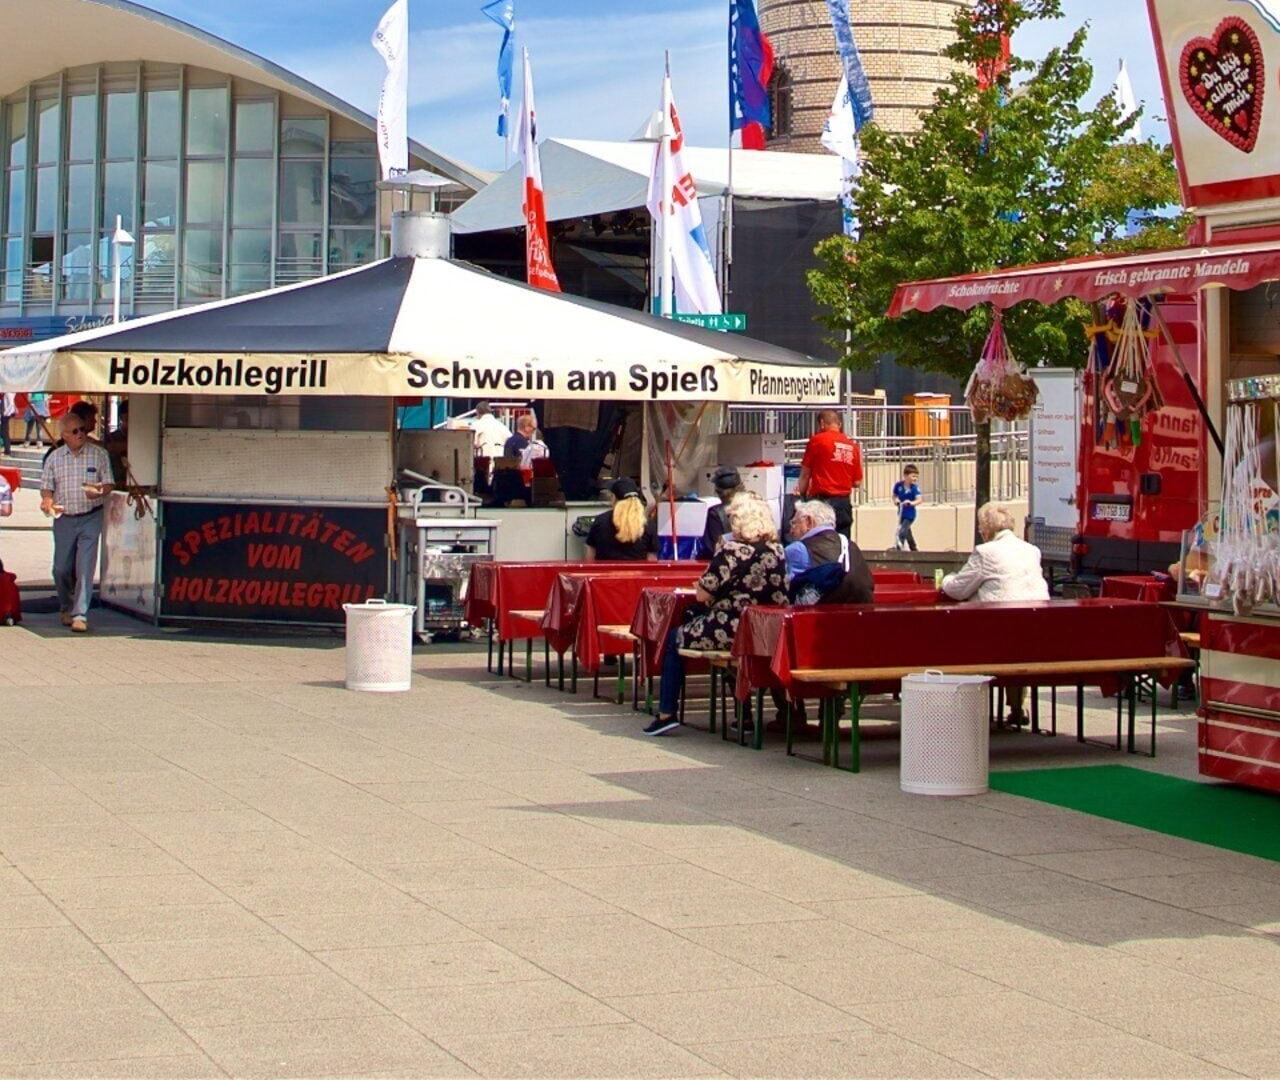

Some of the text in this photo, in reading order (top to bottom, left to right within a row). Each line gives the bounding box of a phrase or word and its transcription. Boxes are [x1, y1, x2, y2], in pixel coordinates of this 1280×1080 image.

[1201, 52, 1241, 89] Du bist
[1210, 67, 1250, 103] alles für
[1222, 89, 1251, 114] mich
[949, 259, 1250, 297] Schokofrüchte frisch gebrannte Mandeln
[108, 357, 327, 393] Holzkohlegrill
[407, 359, 718, 399] Schwein am Spieß
[750, 369, 836, 401] Pfannengerichte
[172, 511, 375, 566] SPEZIALITÄTEN
[247, 543, 302, 570] VOM
